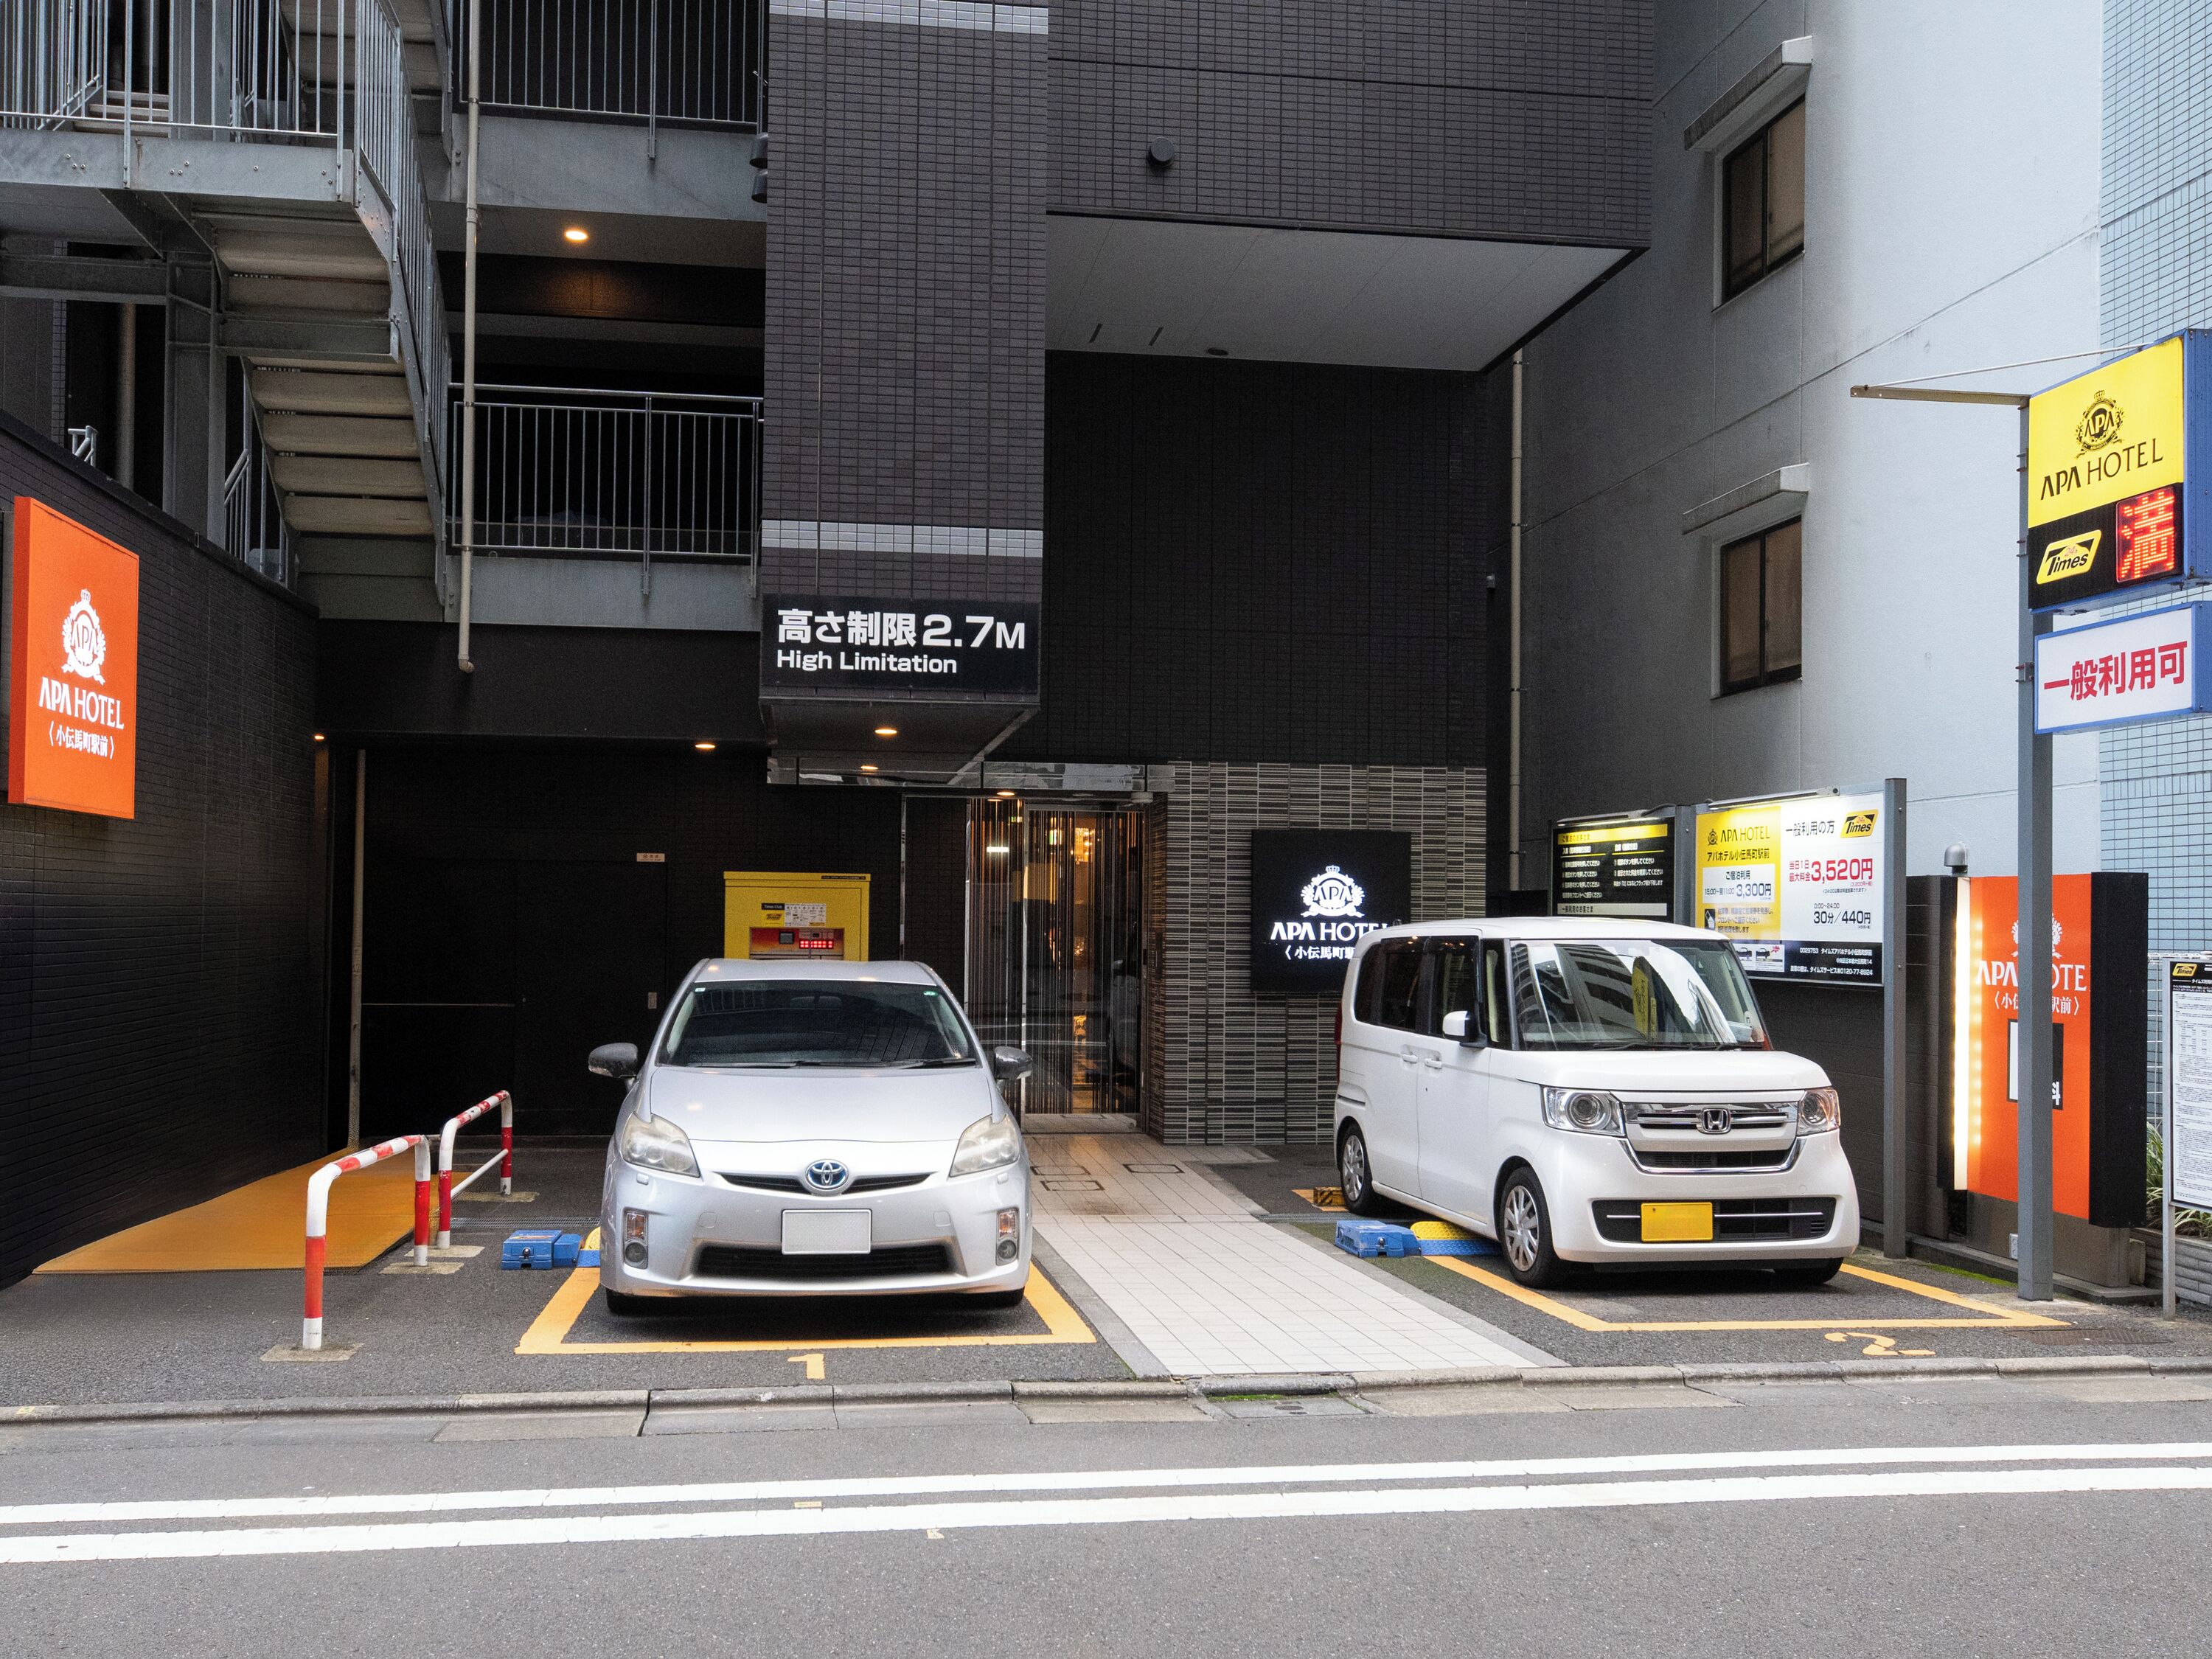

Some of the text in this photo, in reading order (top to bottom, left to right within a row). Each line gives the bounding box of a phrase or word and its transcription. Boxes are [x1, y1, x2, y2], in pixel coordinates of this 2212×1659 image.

[2040, 438, 2163, 501] APA HOTEL
[2121, 491, 2175, 578] 満
[2046, 552, 2089, 576] Times
[778, 608, 1026, 649] 高さ制限2.7M
[776, 650, 957, 674] High Limitation
[2044, 640, 2188, 701] 一般利用可
[38, 677, 125, 729] APA HOTEL
[1720, 826, 1770, 843] APA HOTEL
[1786, 820, 1834, 837] 一般利用の方
[1846, 821, 1871, 835] Times
[1789, 872, 1810, 883] 最大料金
[1811, 858, 1873, 883] 3,520円
[1736, 883, 1771, 898] 3,300円
[1270, 922, 1389, 941] APA HOT
[1284, 945, 1356, 961] 〈小伝馬町駅
[1975, 960, 2018, 987] APA
[1824, 1332, 1936, 1356] 2
[787, 1353, 825, 1380] 1
